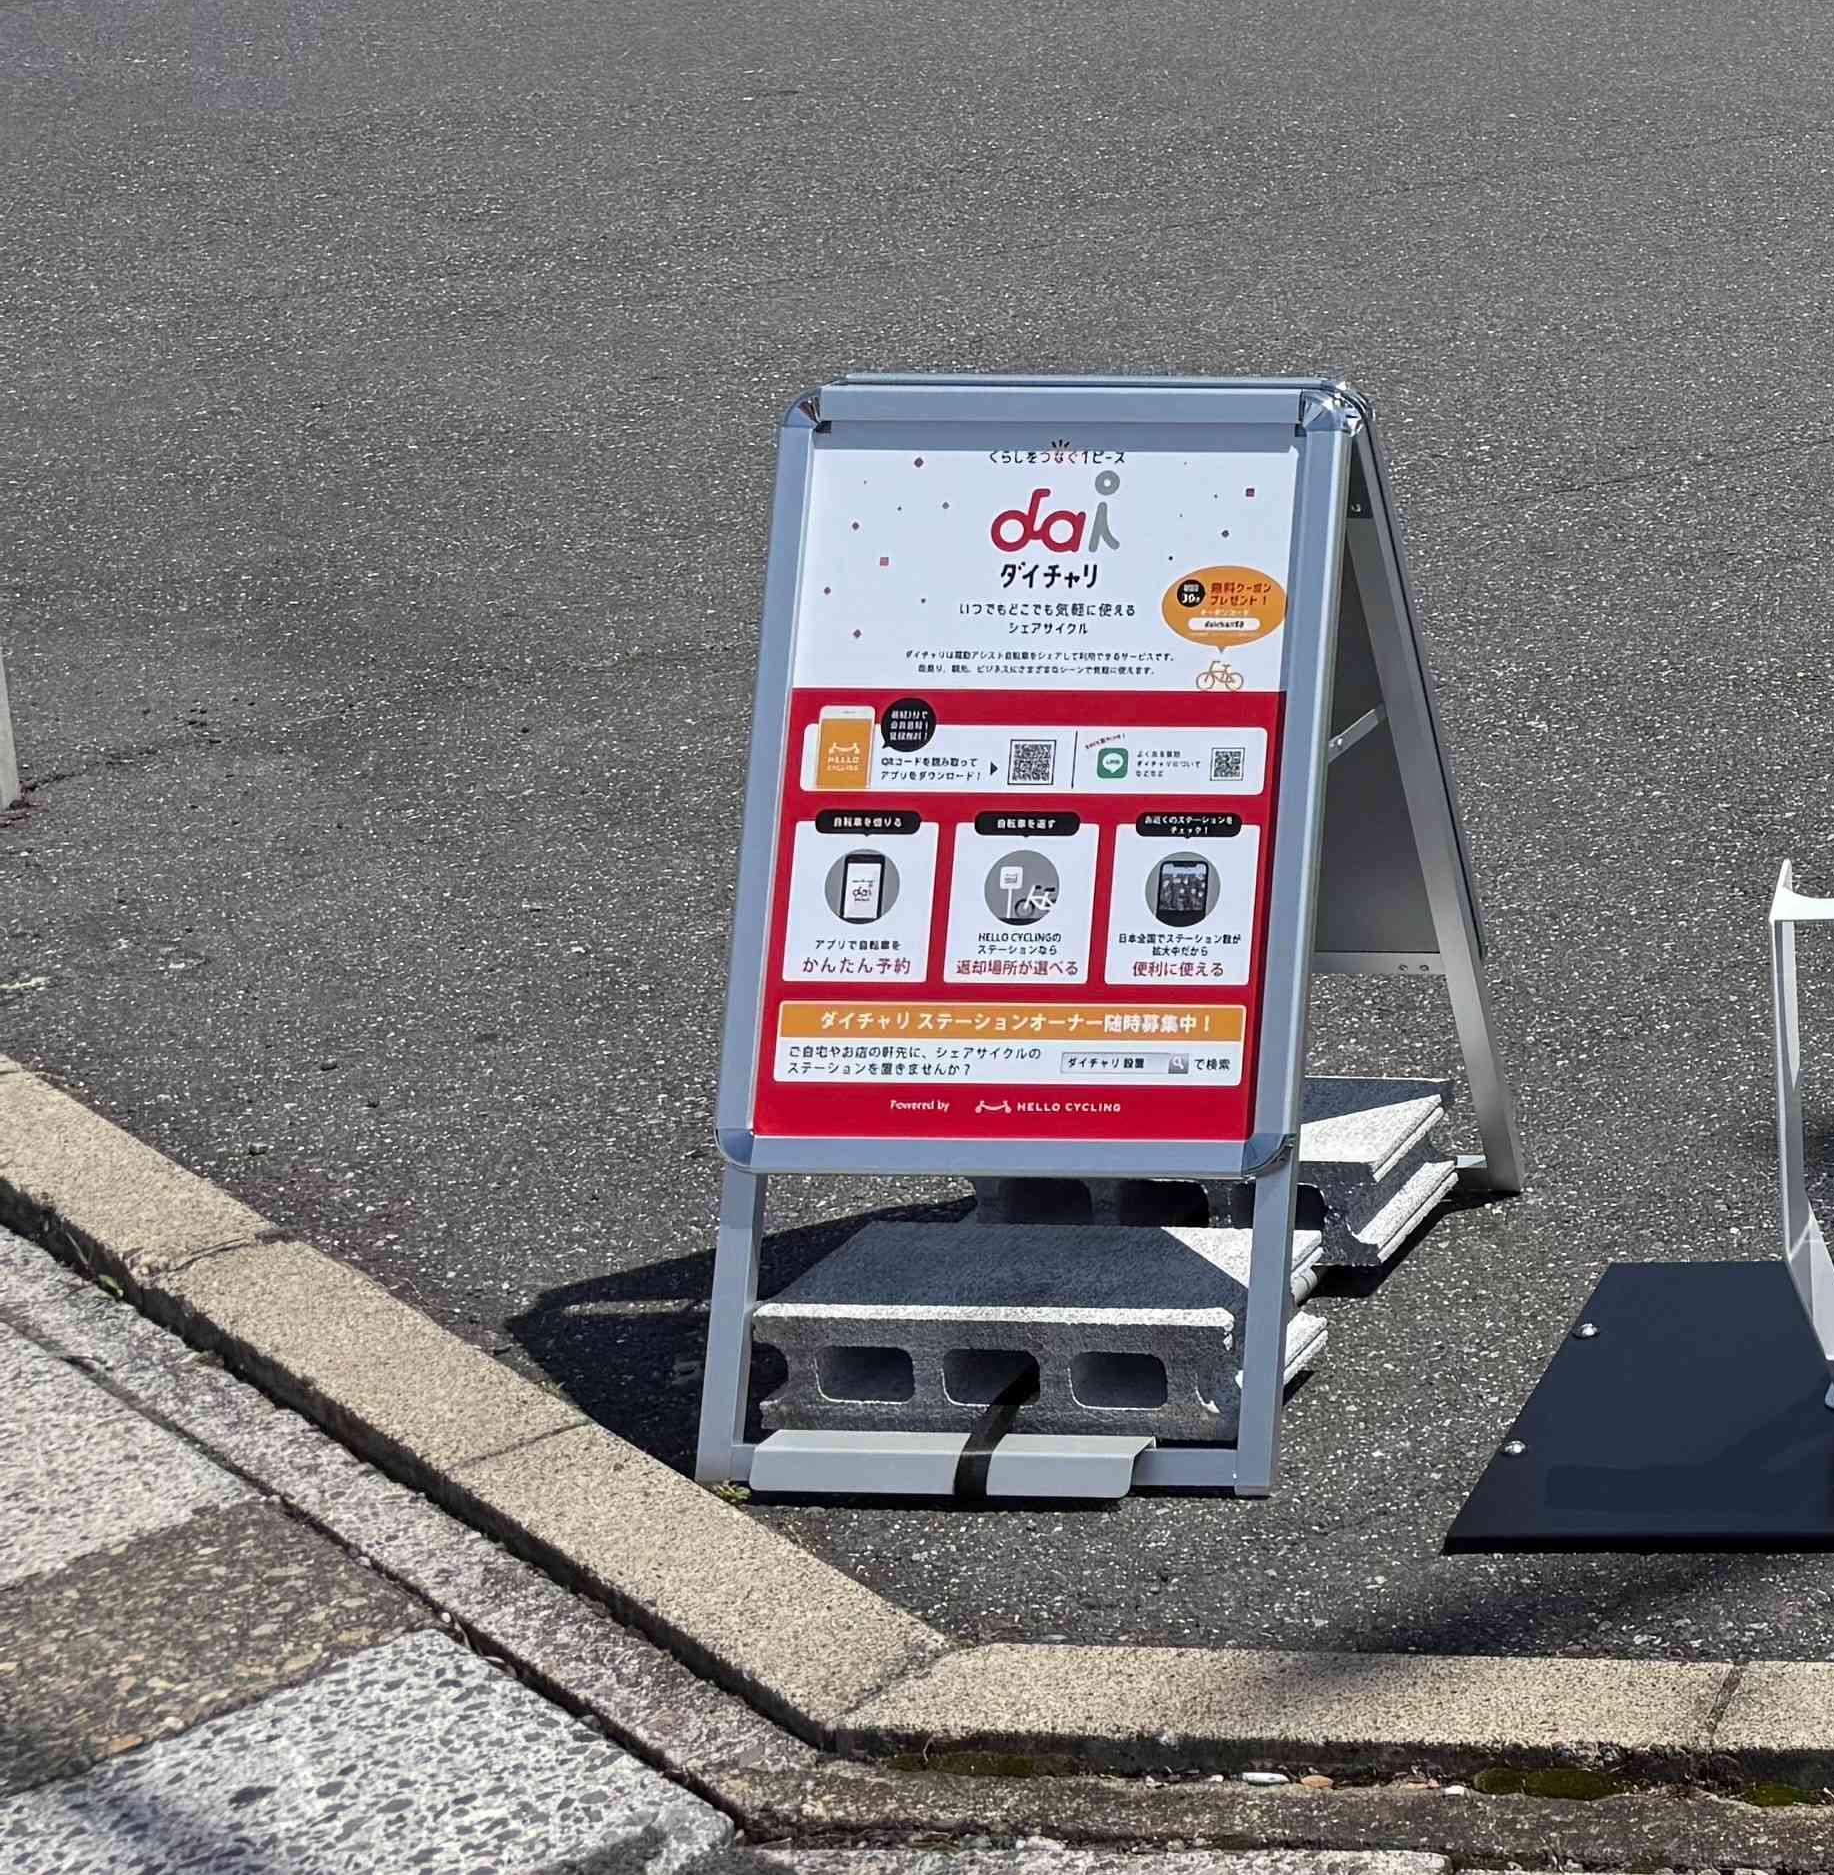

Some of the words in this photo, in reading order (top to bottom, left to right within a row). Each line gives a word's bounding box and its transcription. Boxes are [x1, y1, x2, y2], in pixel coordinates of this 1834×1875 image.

[990, 469, 1121, 554] dai
[1000, 561, 1098, 589] ダイチャリ
[959, 602, 1136, 617] いつでもどこでも気軽に使える
[1008, 622, 1089, 635] シェアサイクル
[815, 939, 902, 951] アプリで自転車を
[977, 932, 1009, 943] HELLO
[977, 944, 1058, 956] ステーションなら
[802, 956, 911, 975] かんたん予約
[955, 959, 1079, 977] 返却場所が選べる
[1131, 961, 1225, 977] 便利に使える
[820, 1011, 911, 1030] ダイチャリ
[917, 1012, 1211, 1034] ステーションオーナー随時募集中！
[787, 1061, 972, 1076] ステーションを置きませんか？
[1067, 1056, 1120, 1069] ダイチャリ
[1123, 1057, 1145, 1069] 設置
[1195, 1057, 1231, 1070] で検索
[889, 1099, 935, 1111] Powered
[937, 1099, 950, 1113] by
[1016, 1101, 1060, 1113] HELLO
[1064, 1101, 1122, 1113] CYCLING
